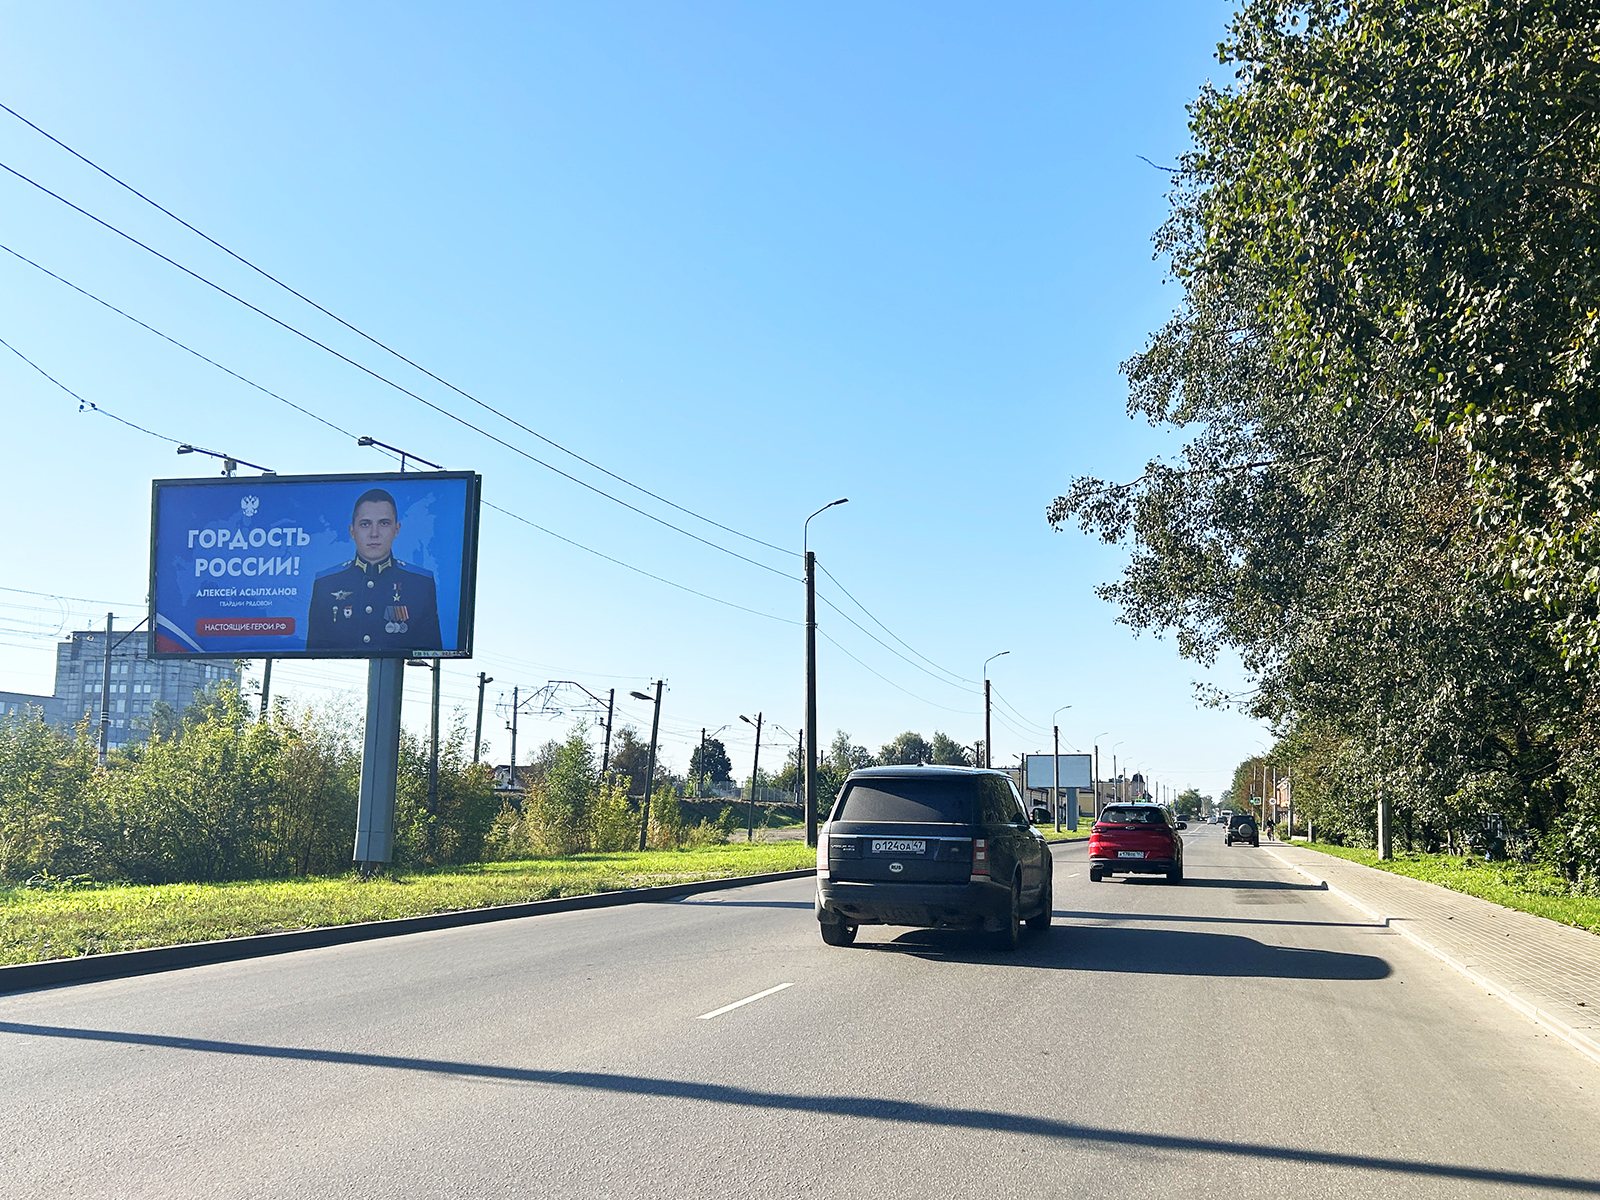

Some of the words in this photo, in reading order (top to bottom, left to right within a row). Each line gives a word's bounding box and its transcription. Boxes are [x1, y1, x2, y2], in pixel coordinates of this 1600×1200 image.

[188, 527, 311, 550] ГОРДОСТЬ
[195, 556, 300, 577] РОССИИ!
[196, 586, 237, 598] АЛЕКСЕЙ
[239, 587, 298, 597] АСЫЛХАНОВ
[204, 623, 287, 632] НАСТОЯЩИЕ-ГЕРОИ.РФ
